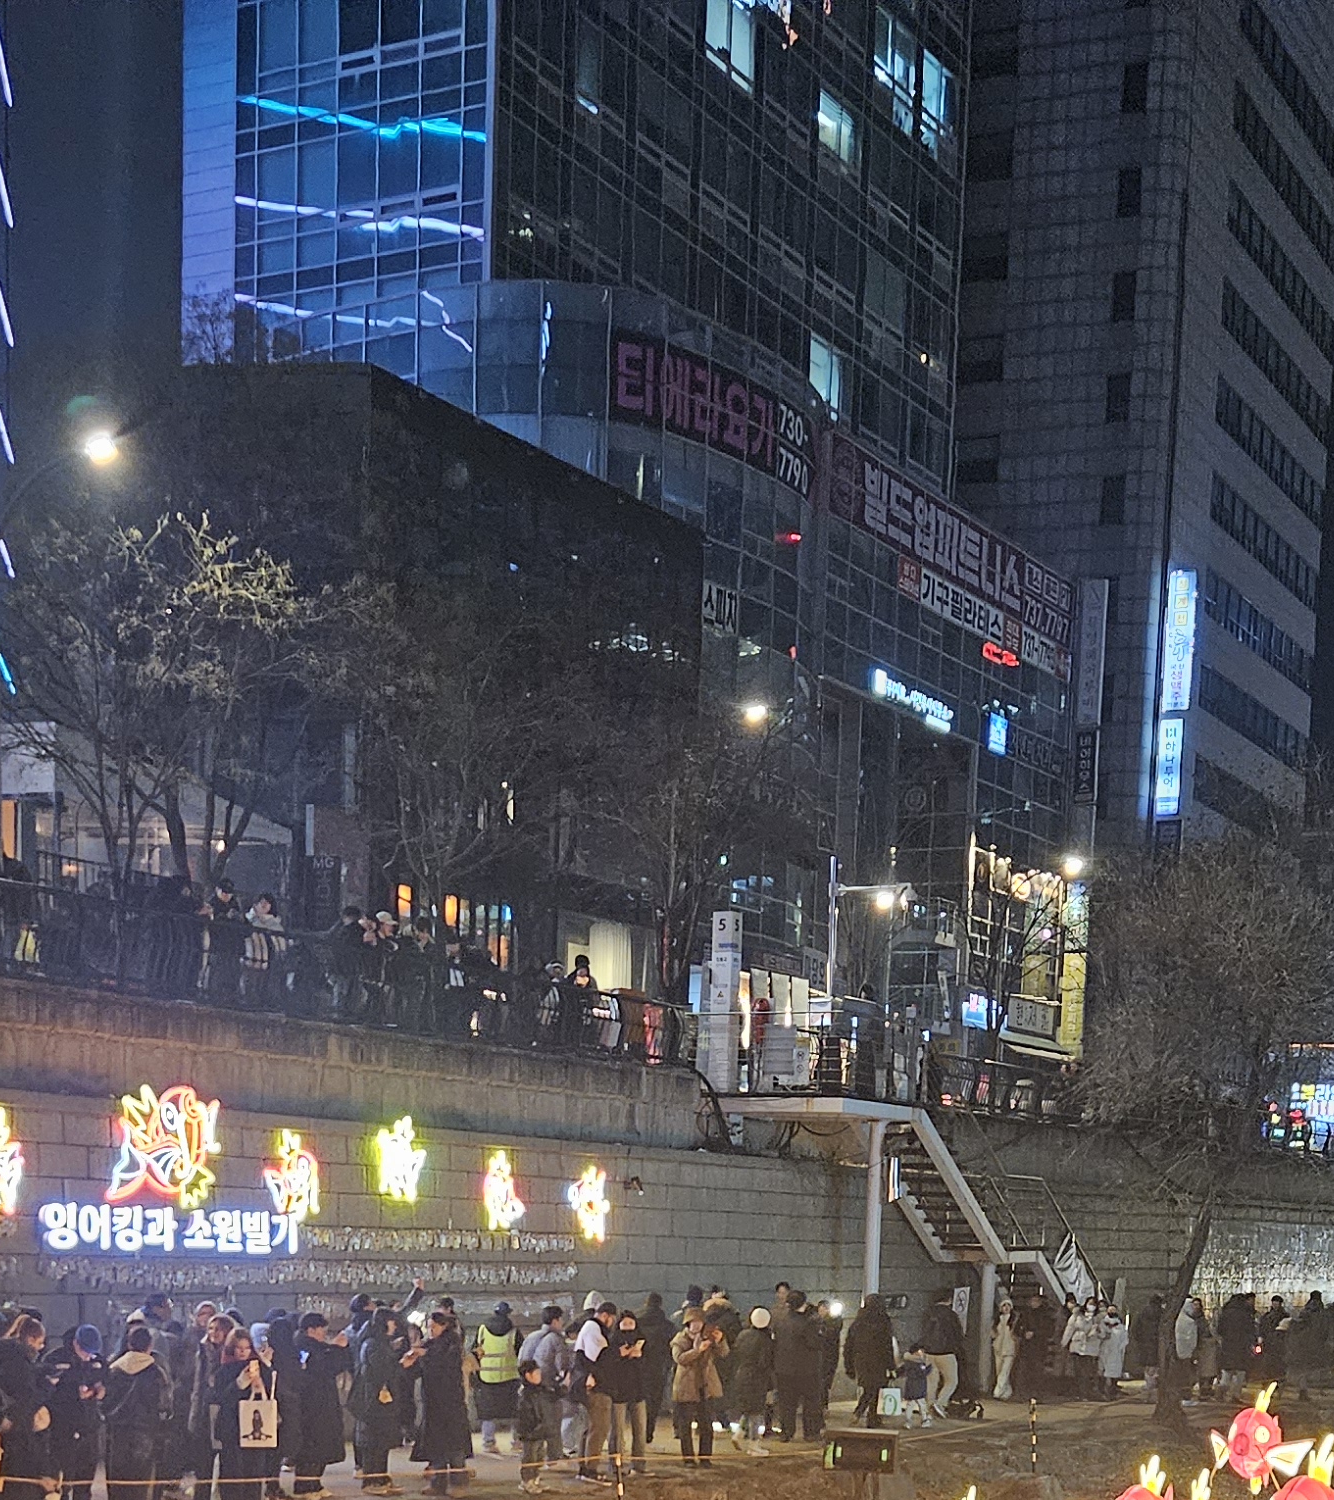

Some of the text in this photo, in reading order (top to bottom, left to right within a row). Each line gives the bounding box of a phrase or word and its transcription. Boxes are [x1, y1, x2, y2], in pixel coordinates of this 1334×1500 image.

[864, 461, 1021, 612] 빌드업피트니스
[922, 573, 1003, 642] 기구필라테스
[1163, 741, 1176, 788] 하나투어
[718, 918, 727, 931] 5
[41, 1201, 299, 1254] 잉어킹과 소원빌기
